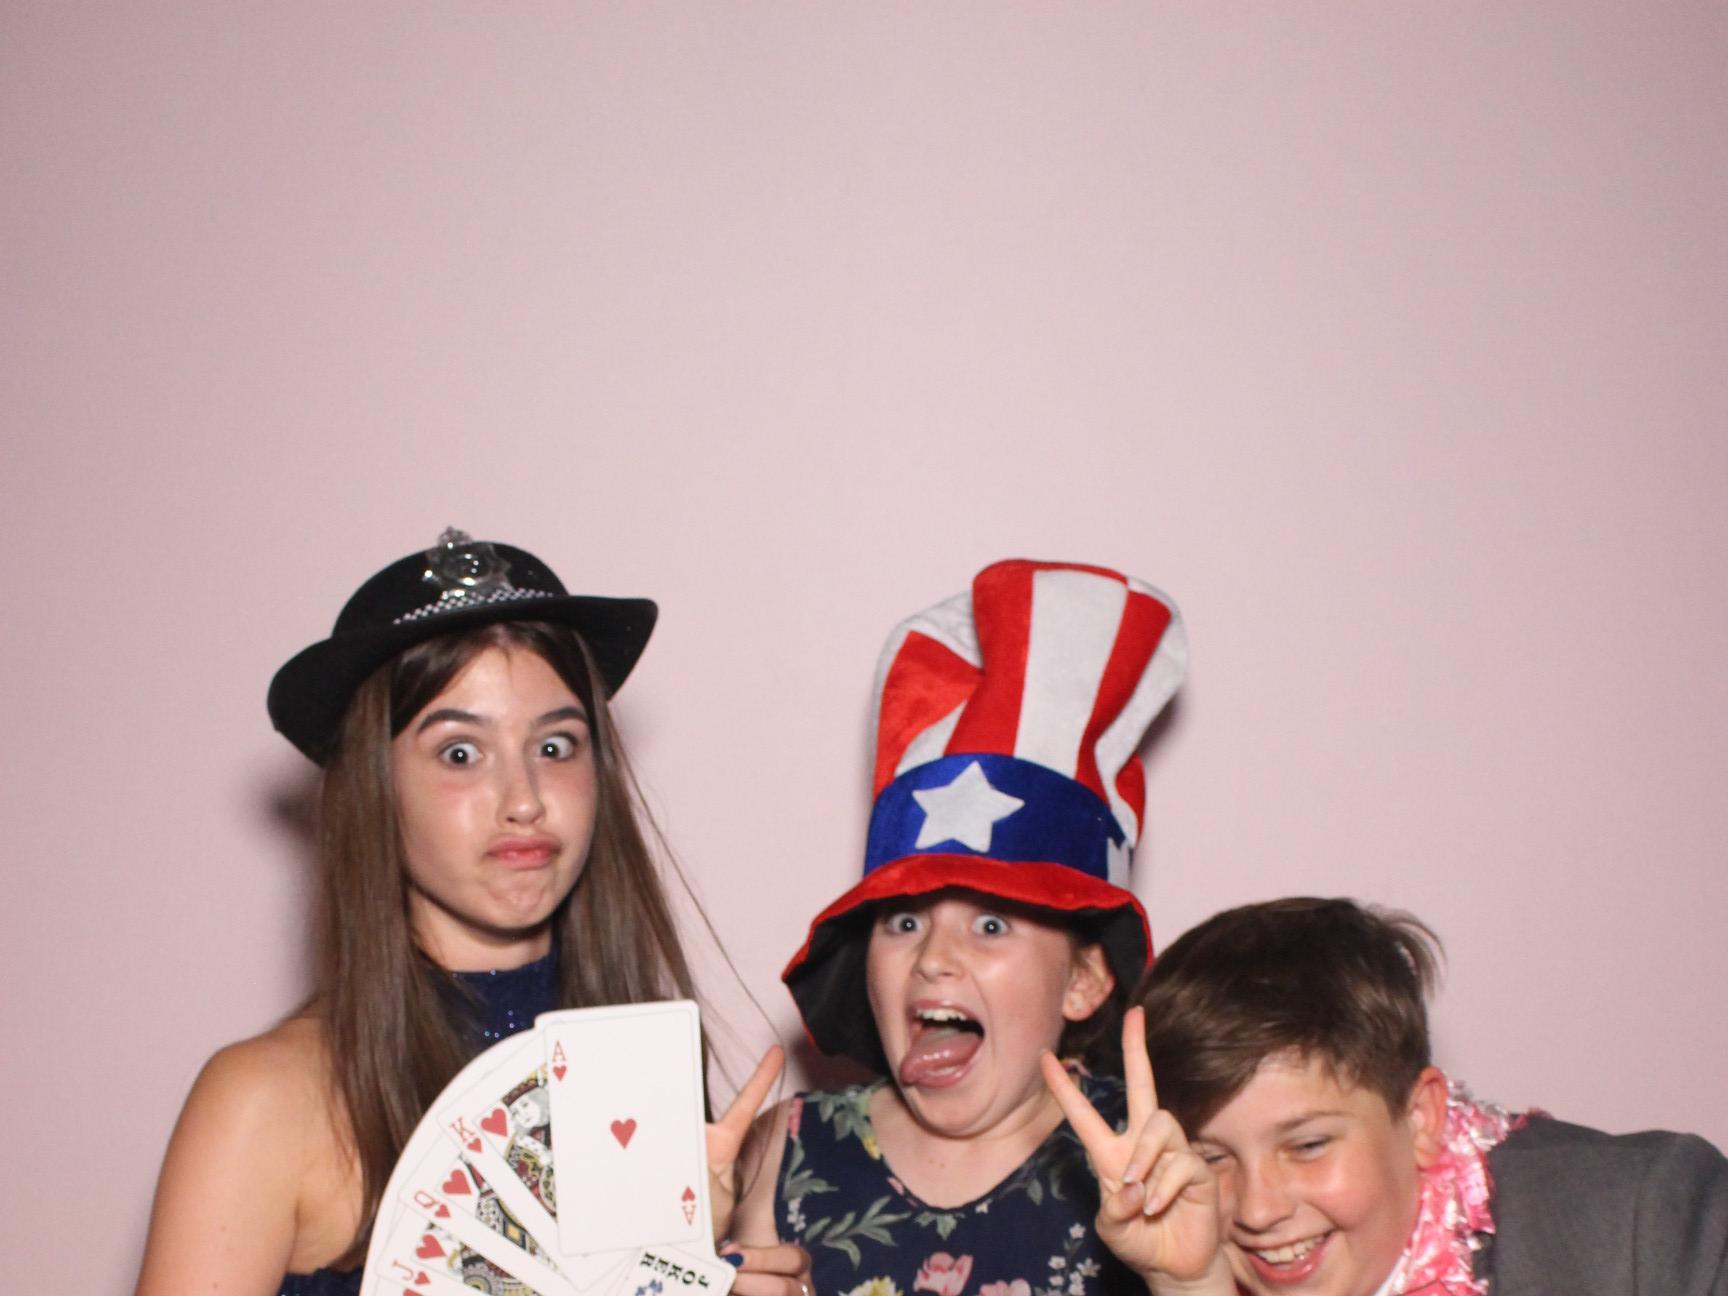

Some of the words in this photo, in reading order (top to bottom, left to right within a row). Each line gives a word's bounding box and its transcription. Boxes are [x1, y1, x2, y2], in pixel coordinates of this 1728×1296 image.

[552, 1040, 567, 1062] A
[448, 1115, 475, 1142] K
[413, 1190, 439, 1210] Q
[682, 1205, 696, 1226] A
[392, 1260, 415, 1281] J
[640, 1251, 710, 1289] JOKER
